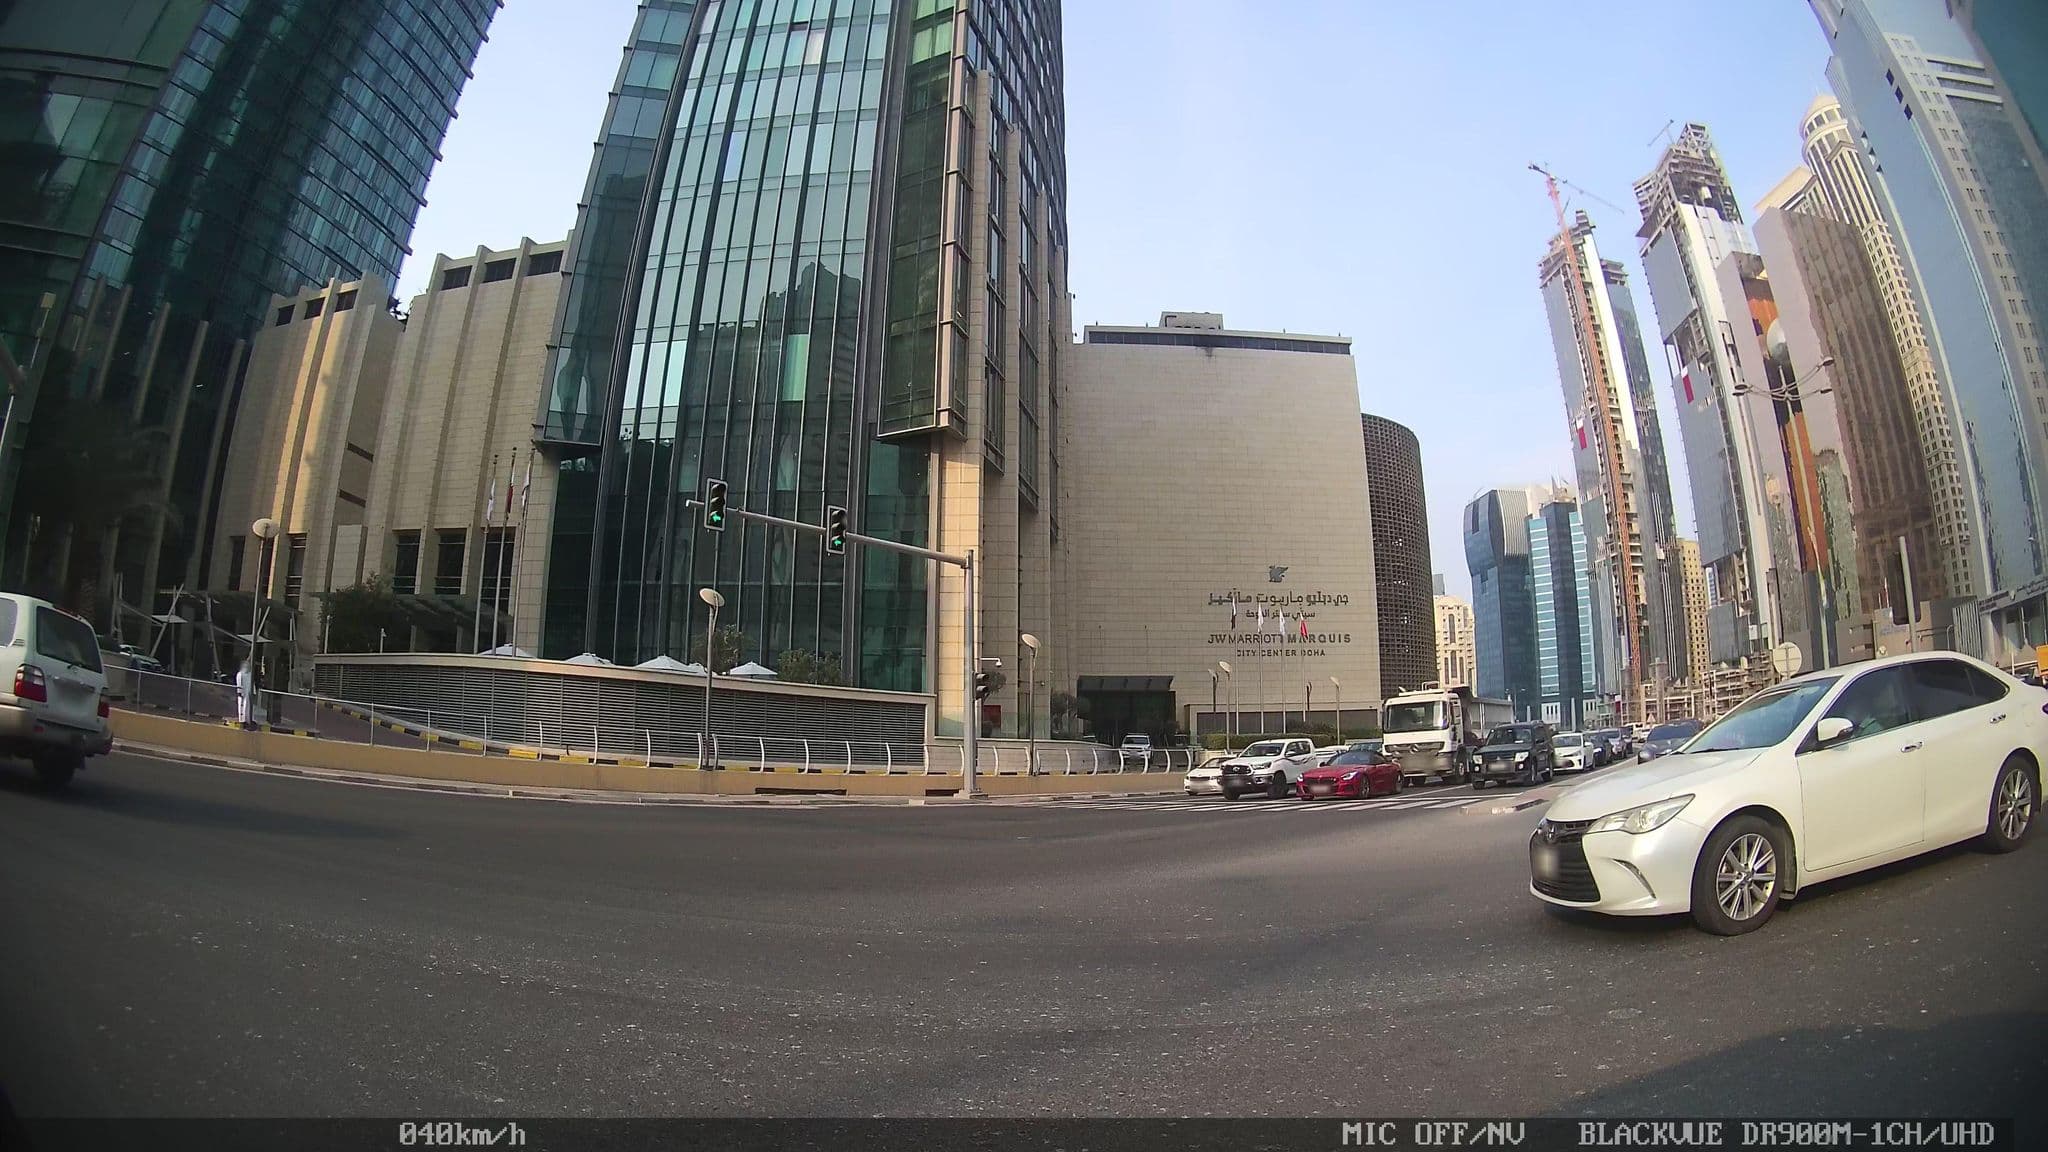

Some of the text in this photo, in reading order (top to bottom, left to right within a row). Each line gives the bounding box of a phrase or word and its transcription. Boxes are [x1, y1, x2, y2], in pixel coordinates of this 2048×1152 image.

[1208, 633, 1351, 644] JW MARRIOTT MARQUIS
[1237, 649, 1326, 657] CITY CENTER DOHA
